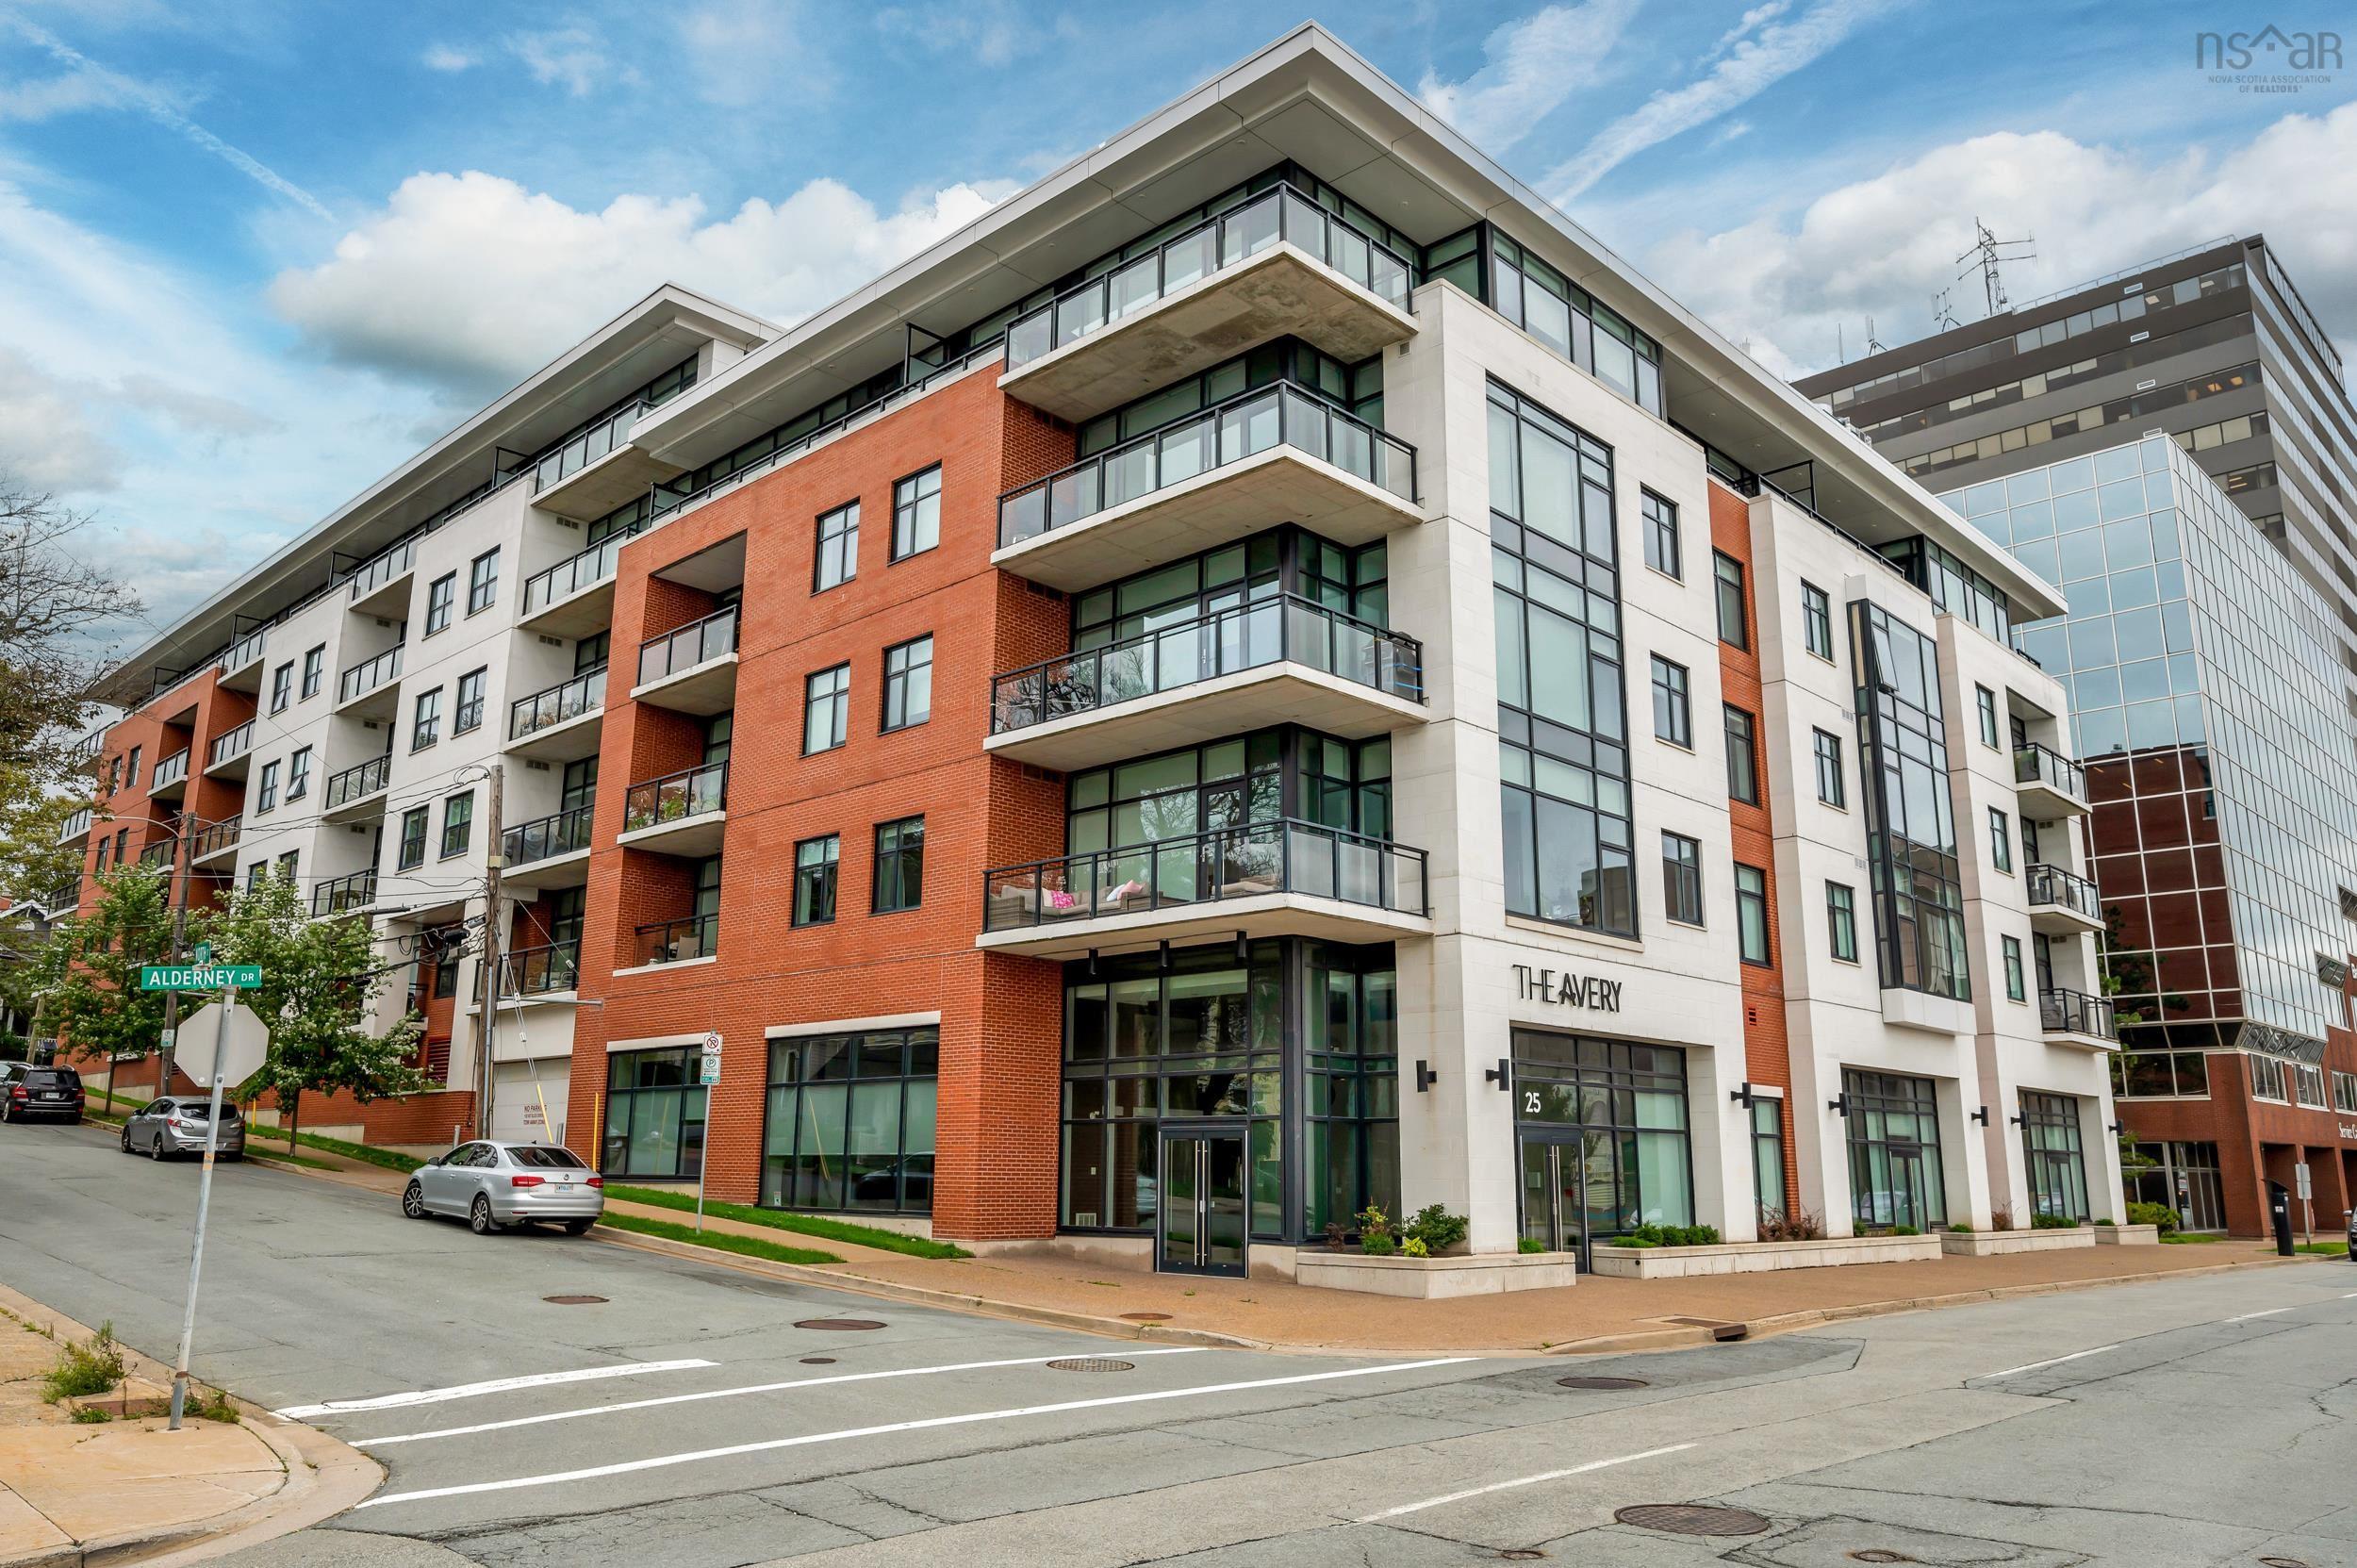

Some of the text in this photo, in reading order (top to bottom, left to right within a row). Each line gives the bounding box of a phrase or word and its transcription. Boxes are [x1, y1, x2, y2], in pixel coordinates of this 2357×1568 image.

[149, 970, 255, 986] ALDERNEY DR
[1512, 964, 1623, 1013] THE AVERY
[1525, 1091, 1541, 1114] 25
